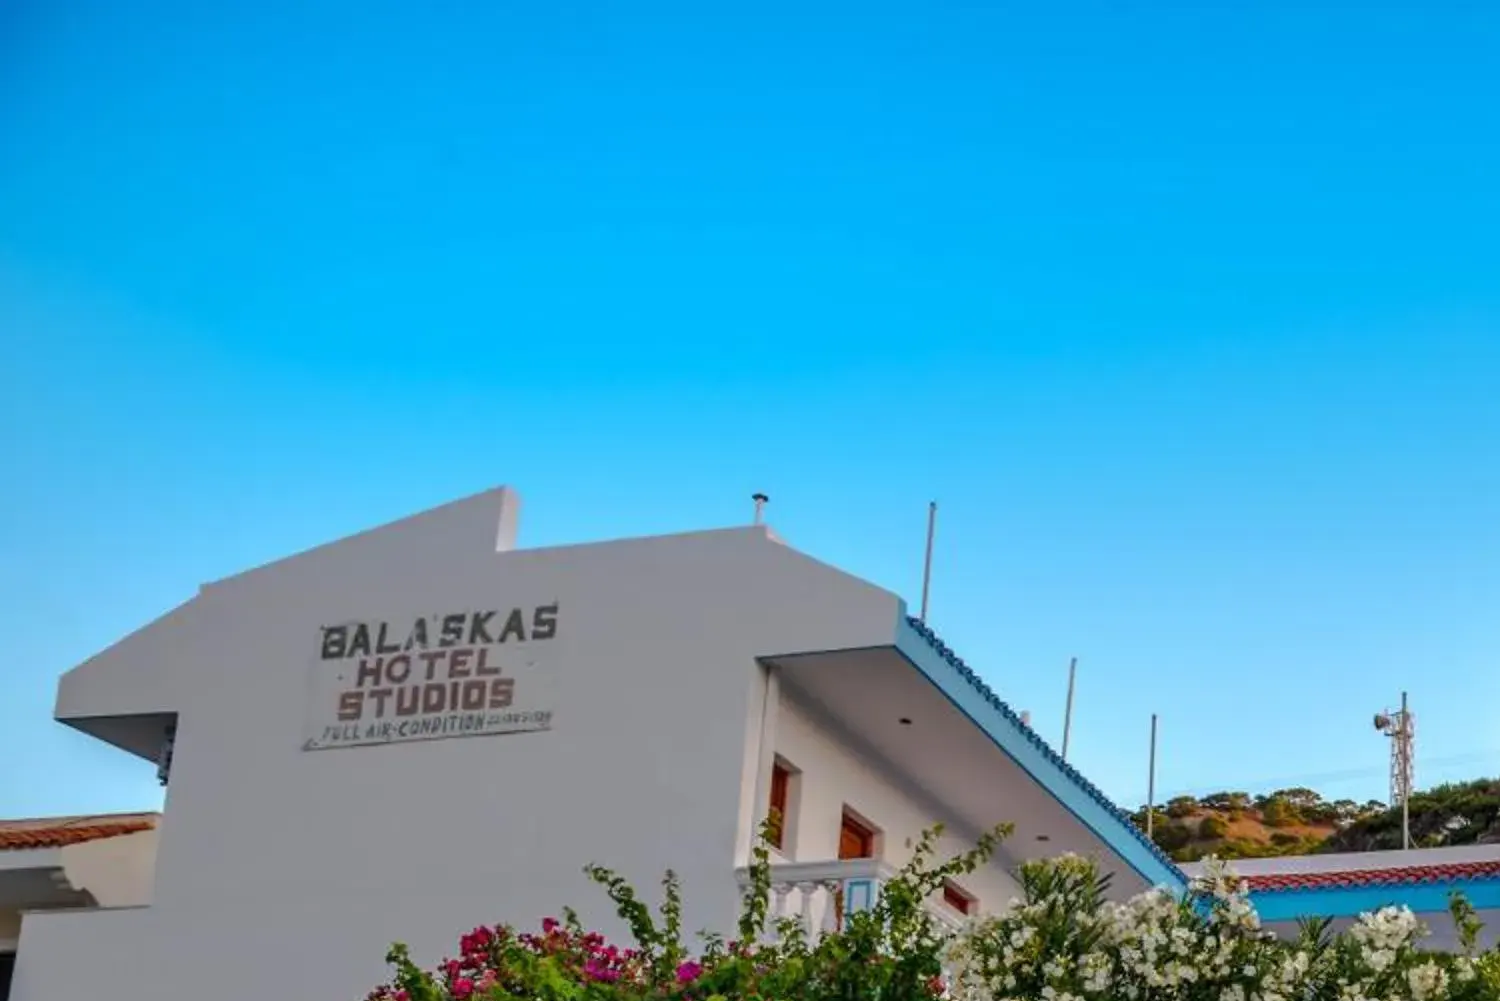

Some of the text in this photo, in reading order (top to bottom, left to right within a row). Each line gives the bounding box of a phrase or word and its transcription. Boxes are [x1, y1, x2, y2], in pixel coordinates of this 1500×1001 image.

[320, 604, 558, 660] BALASKAS
[357, 648, 502, 688] HOTEL
[337, 678, 515, 722] STUDIOS
